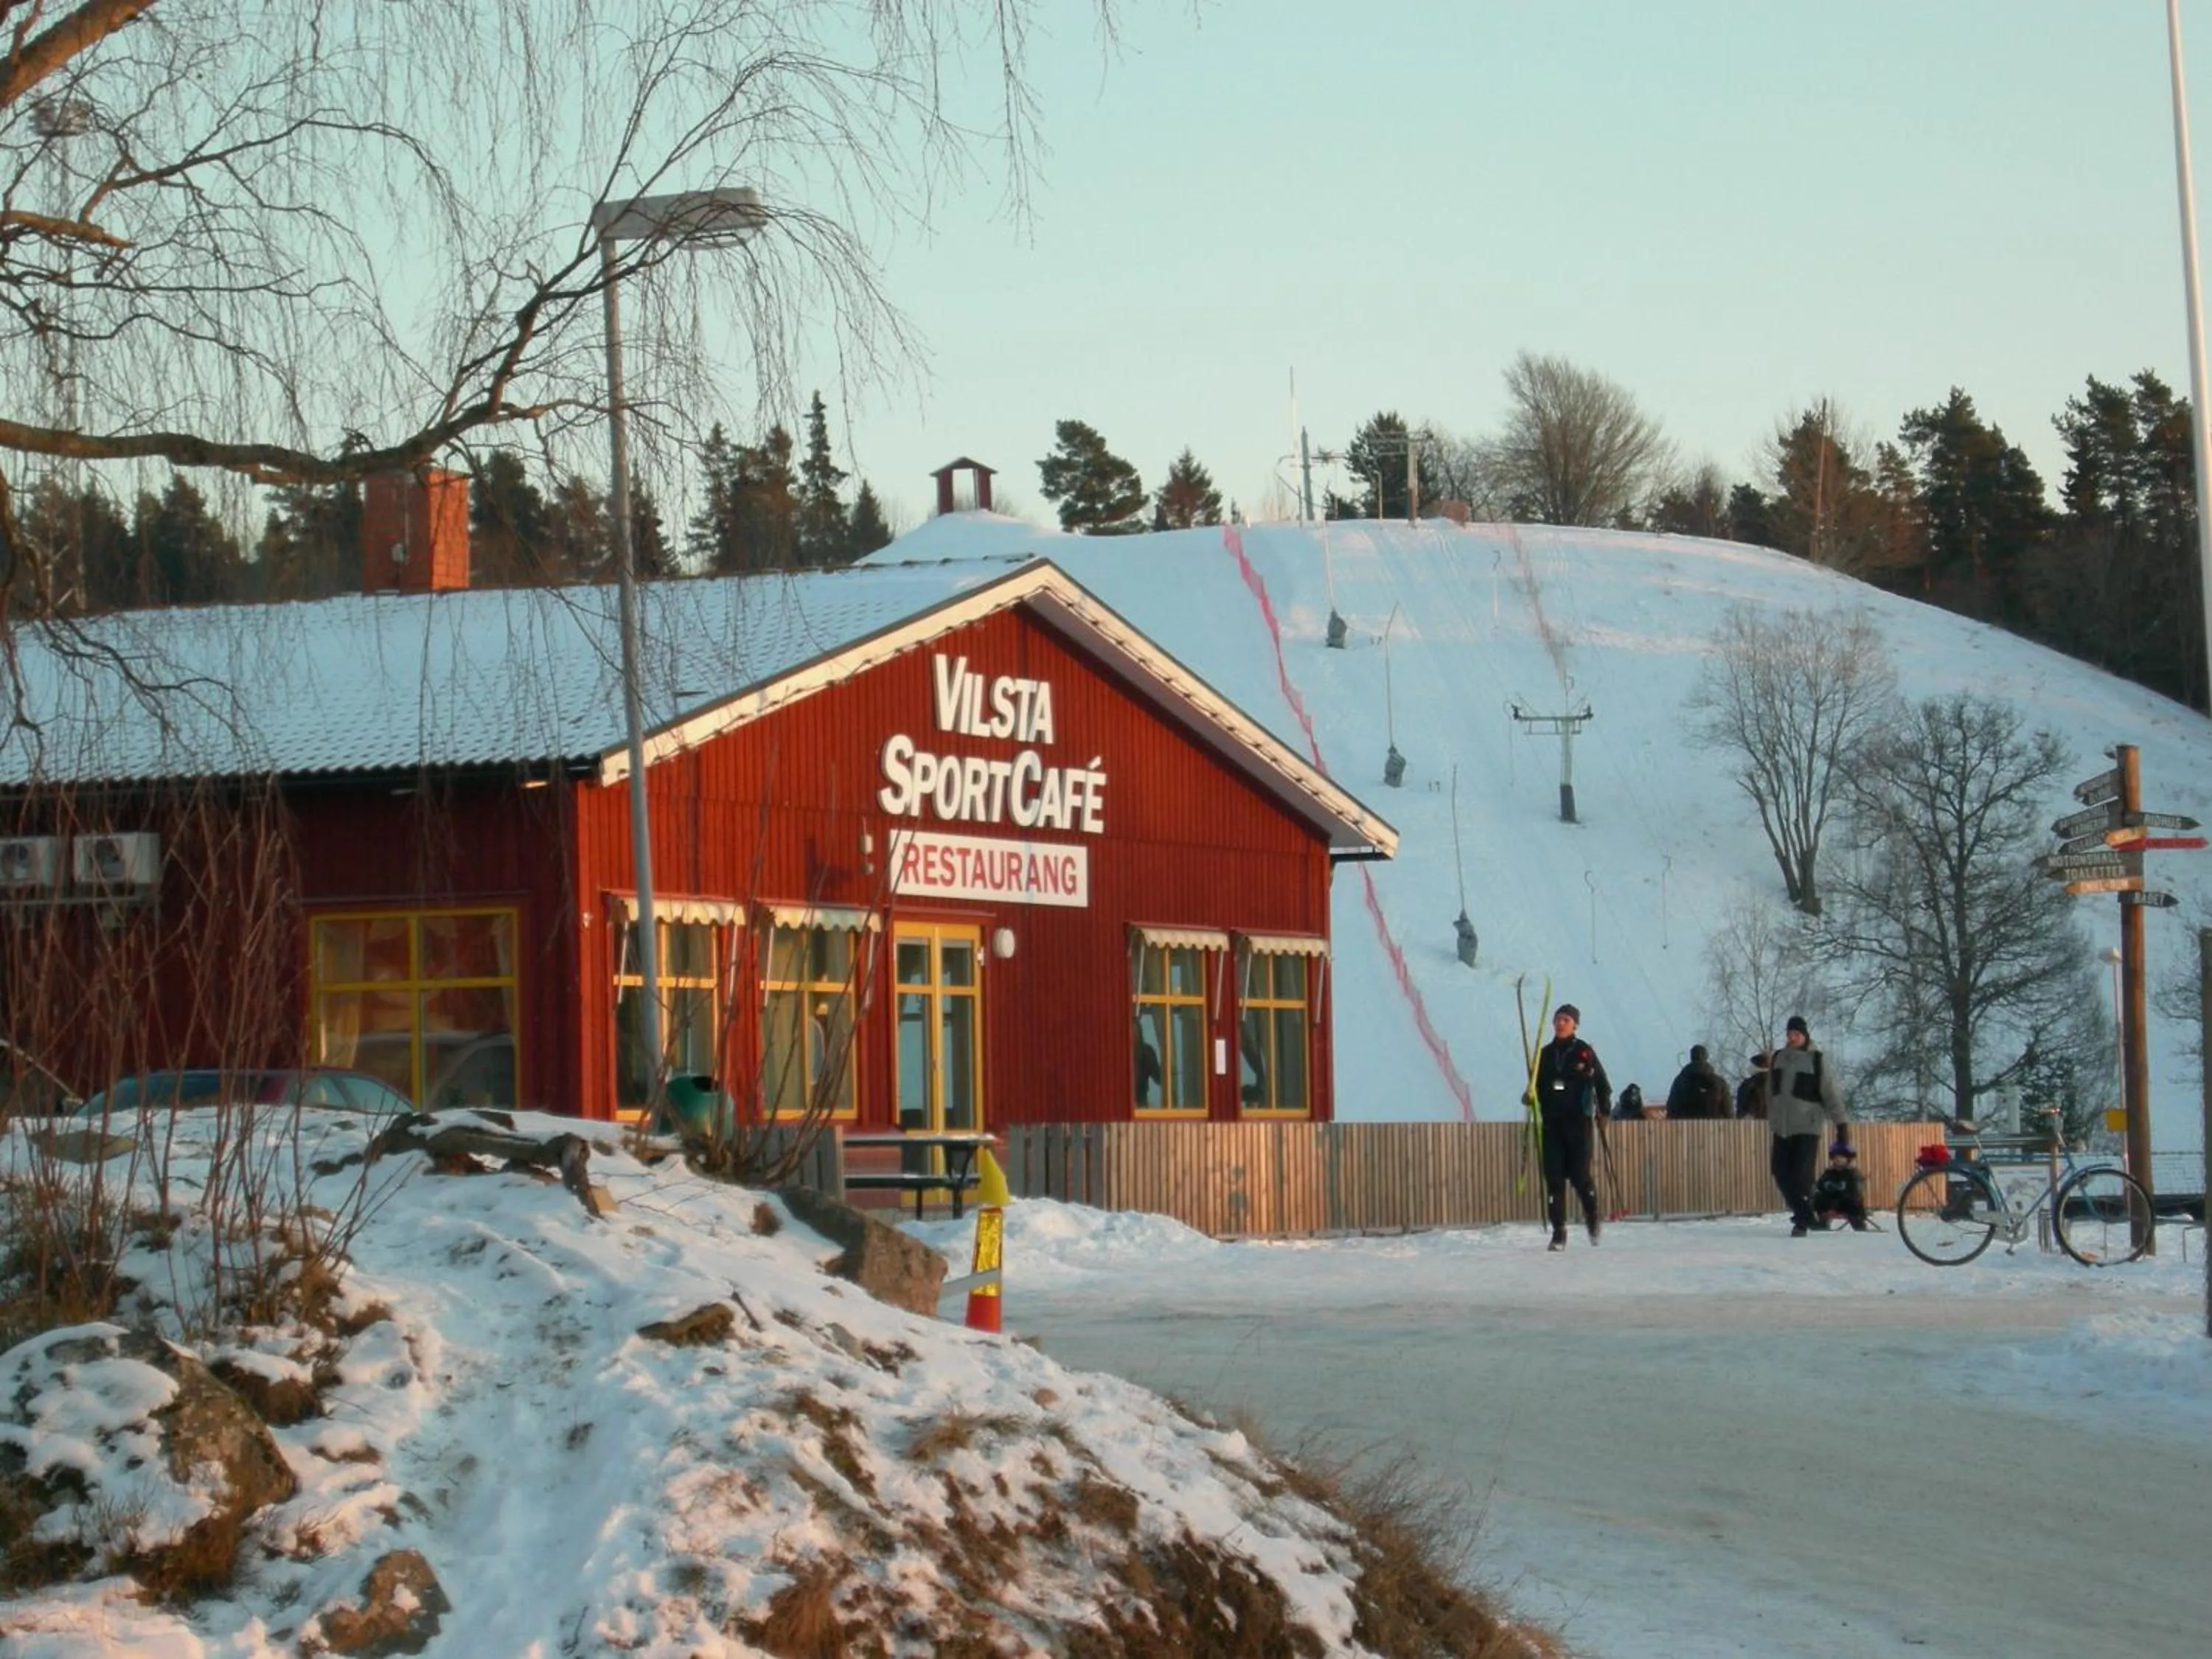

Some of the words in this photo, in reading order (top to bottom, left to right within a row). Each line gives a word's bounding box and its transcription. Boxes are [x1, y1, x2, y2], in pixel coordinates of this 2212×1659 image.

[934, 653, 1054, 744] VILSTA
[878, 734, 1107, 834] SPORTCAFÉ
[902, 842, 1077, 896] RESTAURANG
[2064, 865, 2126, 880] TOALETTER
